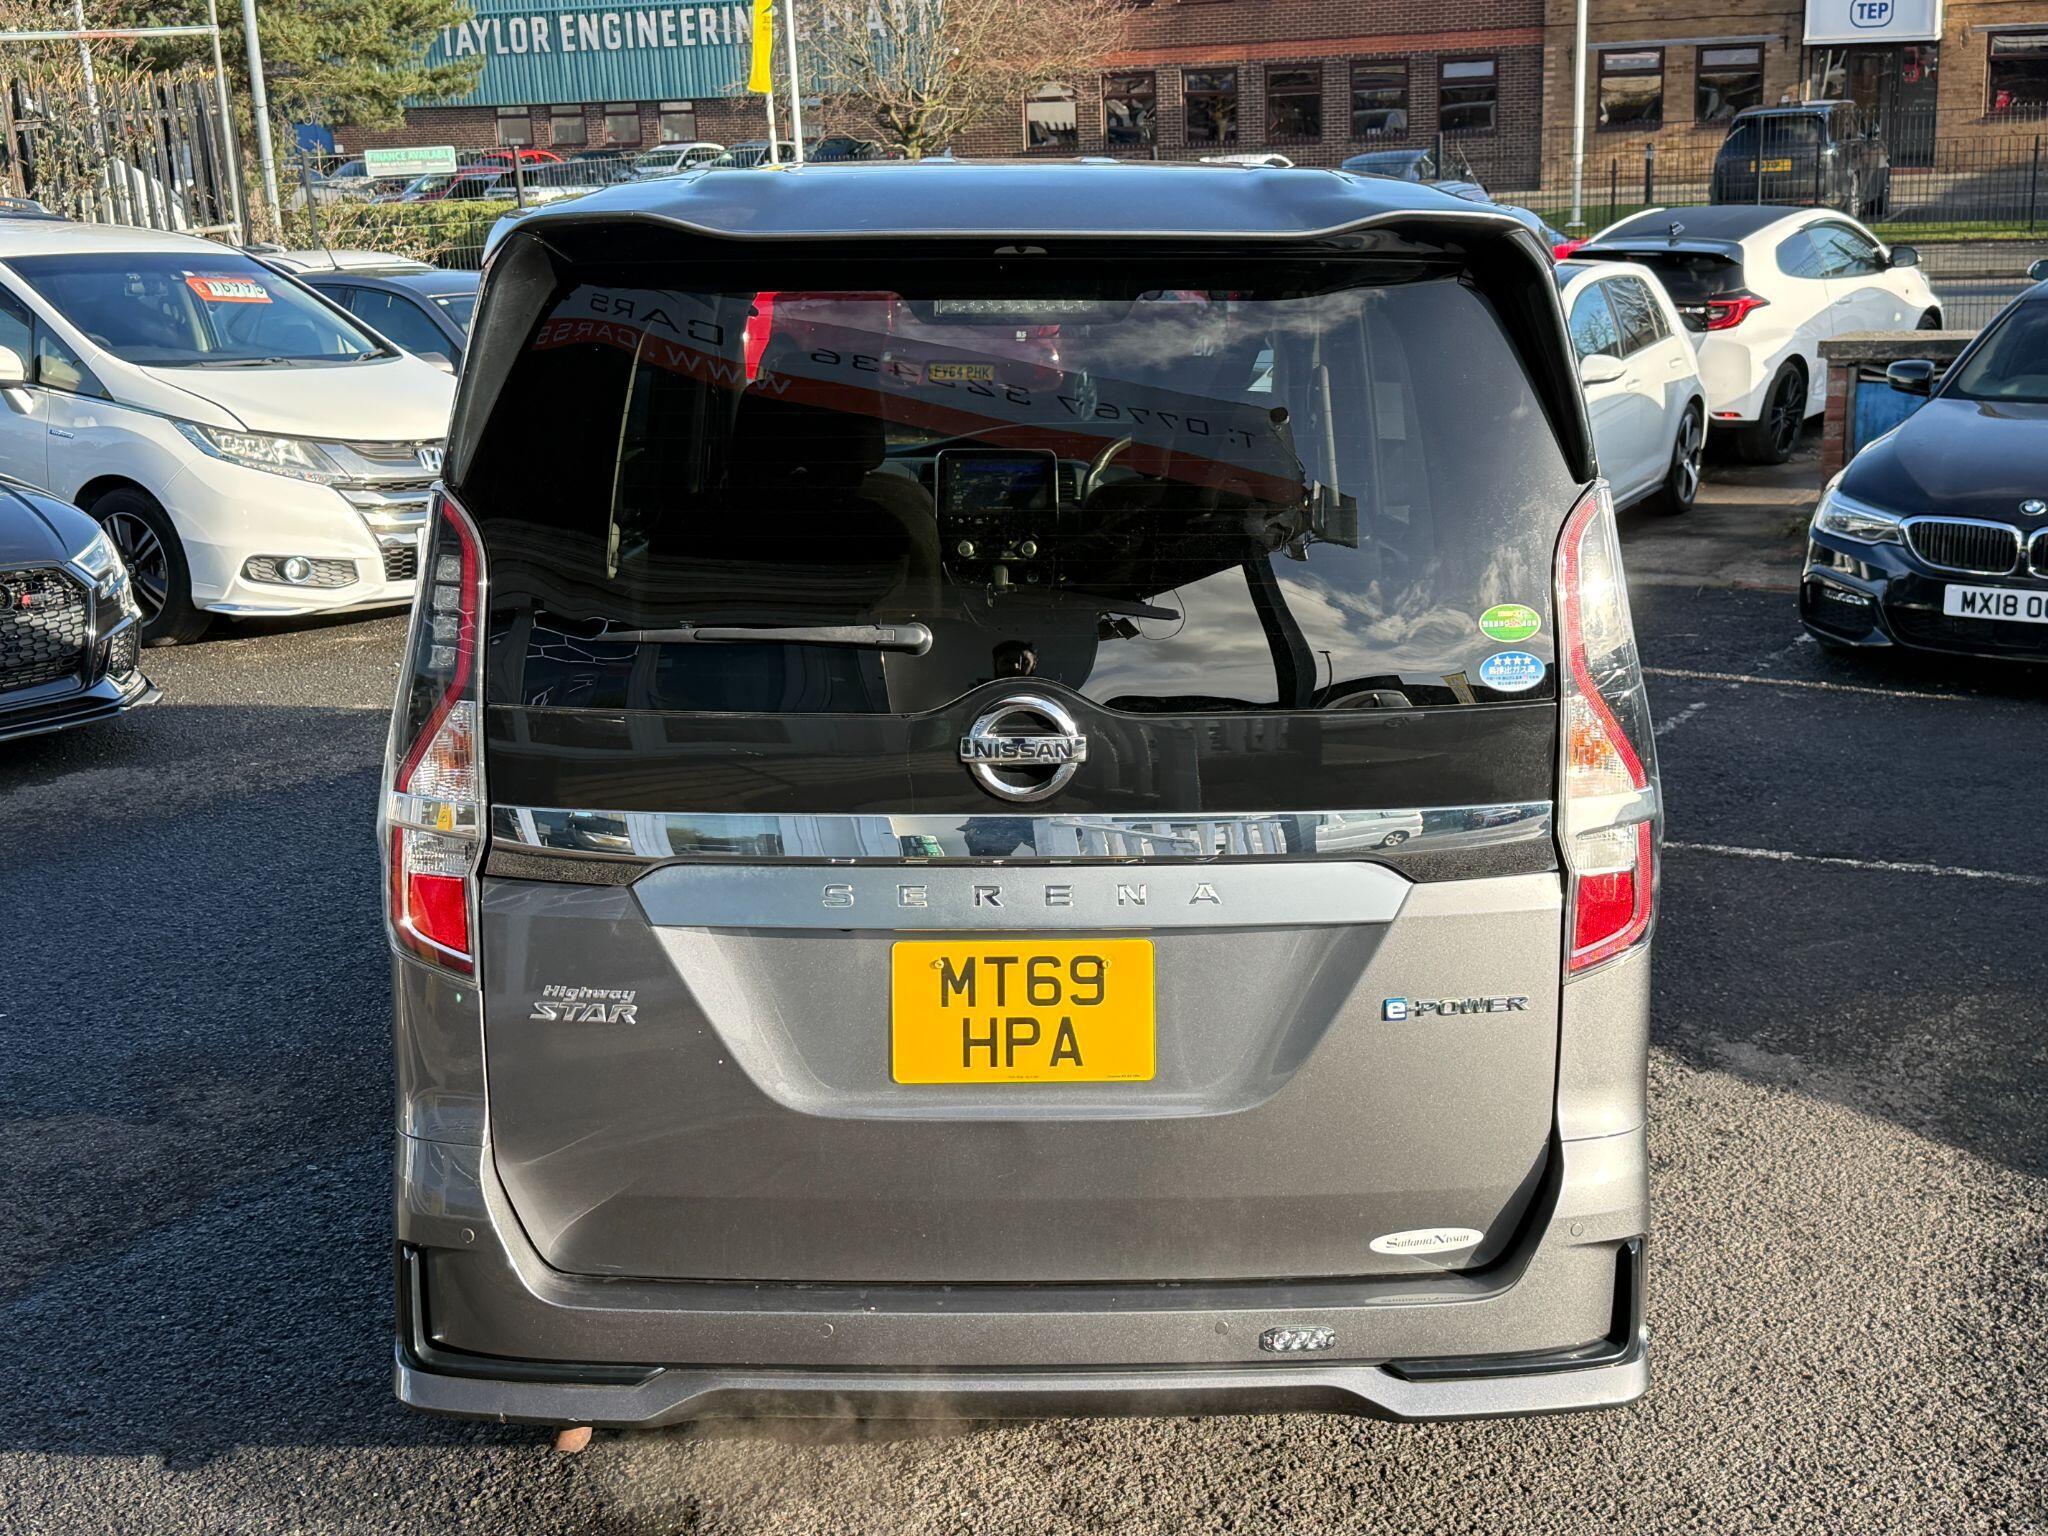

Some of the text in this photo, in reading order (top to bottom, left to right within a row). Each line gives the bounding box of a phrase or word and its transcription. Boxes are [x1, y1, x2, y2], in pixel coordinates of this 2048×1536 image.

[1857, 3, 1889, 19] TEP
[443, 16, 550, 57] TAYLOR
[559, 5, 779, 52] ENGINEERIN
[368, 151, 406, 163] FINANCE
[1961, 590, 2018, 616] MX18
[974, 743, 1073, 759] NISSAN
[821, 883, 1223, 908] SERENA
[940, 954, 1106, 1008] MT69
[542, 984, 636, 1004] Highway
[529, 1001, 638, 1025] STAR
[962, 1016, 1084, 1068] HPA
